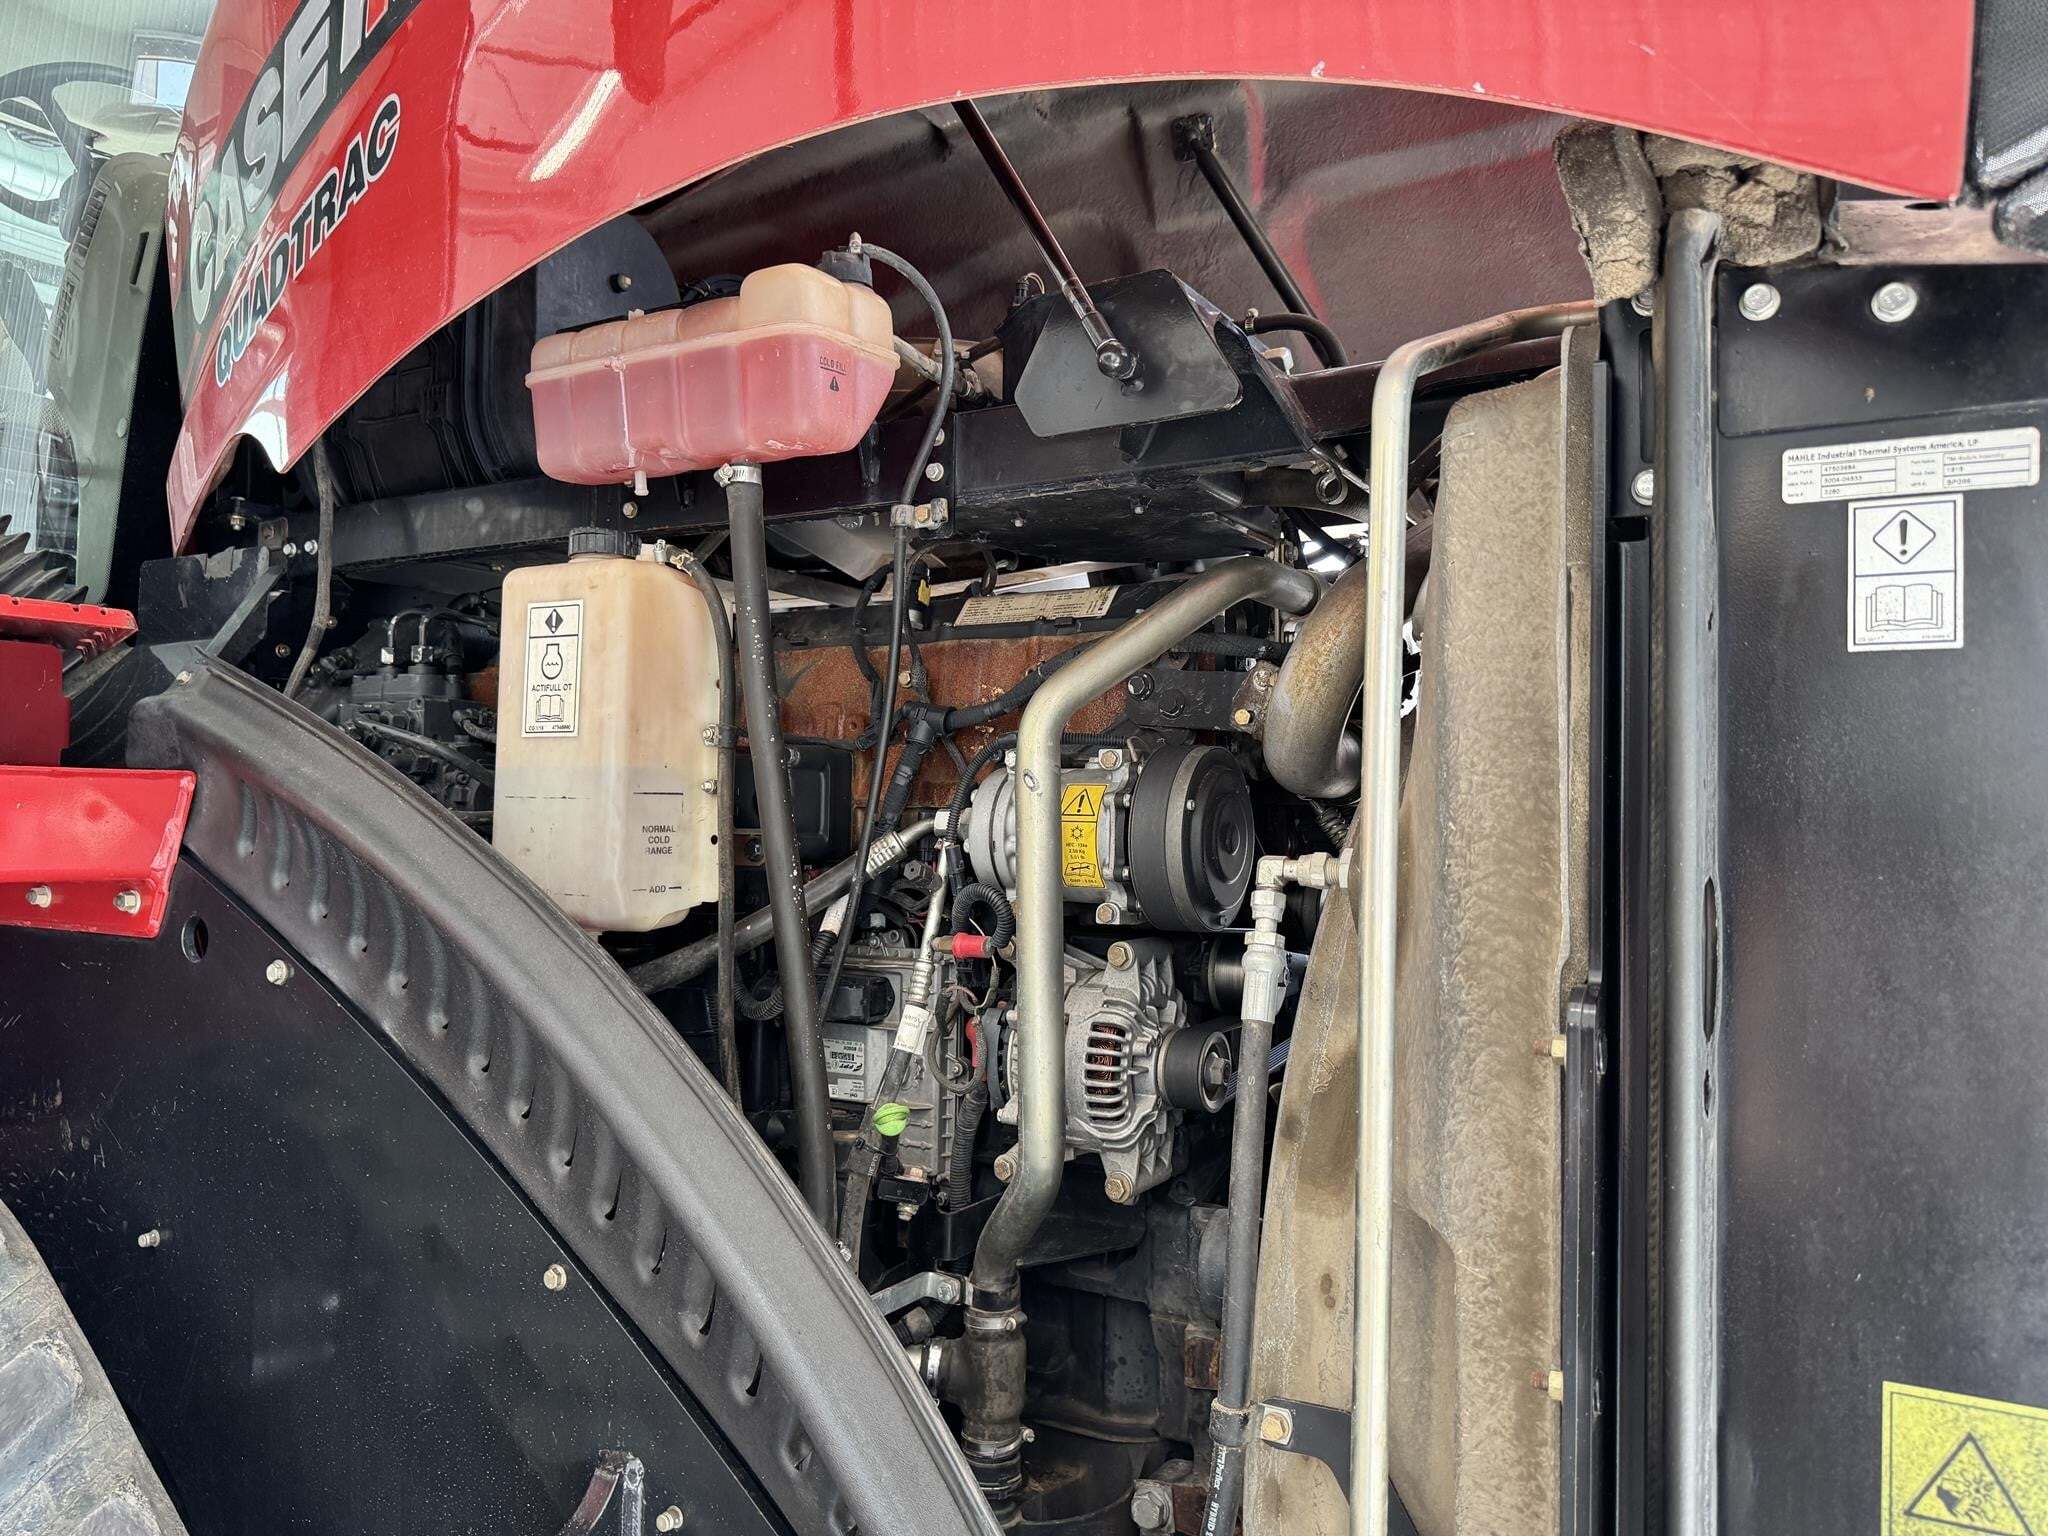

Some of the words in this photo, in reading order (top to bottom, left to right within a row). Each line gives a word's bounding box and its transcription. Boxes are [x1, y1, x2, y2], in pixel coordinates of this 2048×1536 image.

[190, 0, 330, 325] CASE
[215, 92, 401, 387] QUADTRAC
[820, 356, 835, 368] COLD
[1788, 455, 1815, 463] MAHLE
[1818, 451, 1856, 460] Industrial
[1858, 447, 1891, 457] Thermal
[1893, 443, 1927, 454] Systems
[1930, 440, 1964, 450] America,
[532, 683, 561, 692] ACTIFULL
[562, 683, 572, 691] OT
[642, 825, 676, 833] NORMAL
[647, 835, 670, 844] COLD
[645, 846, 673, 855] RANGE
[649, 884, 667, 893] ADD
[1208, 1502, 1219, 1531] HYBRID
